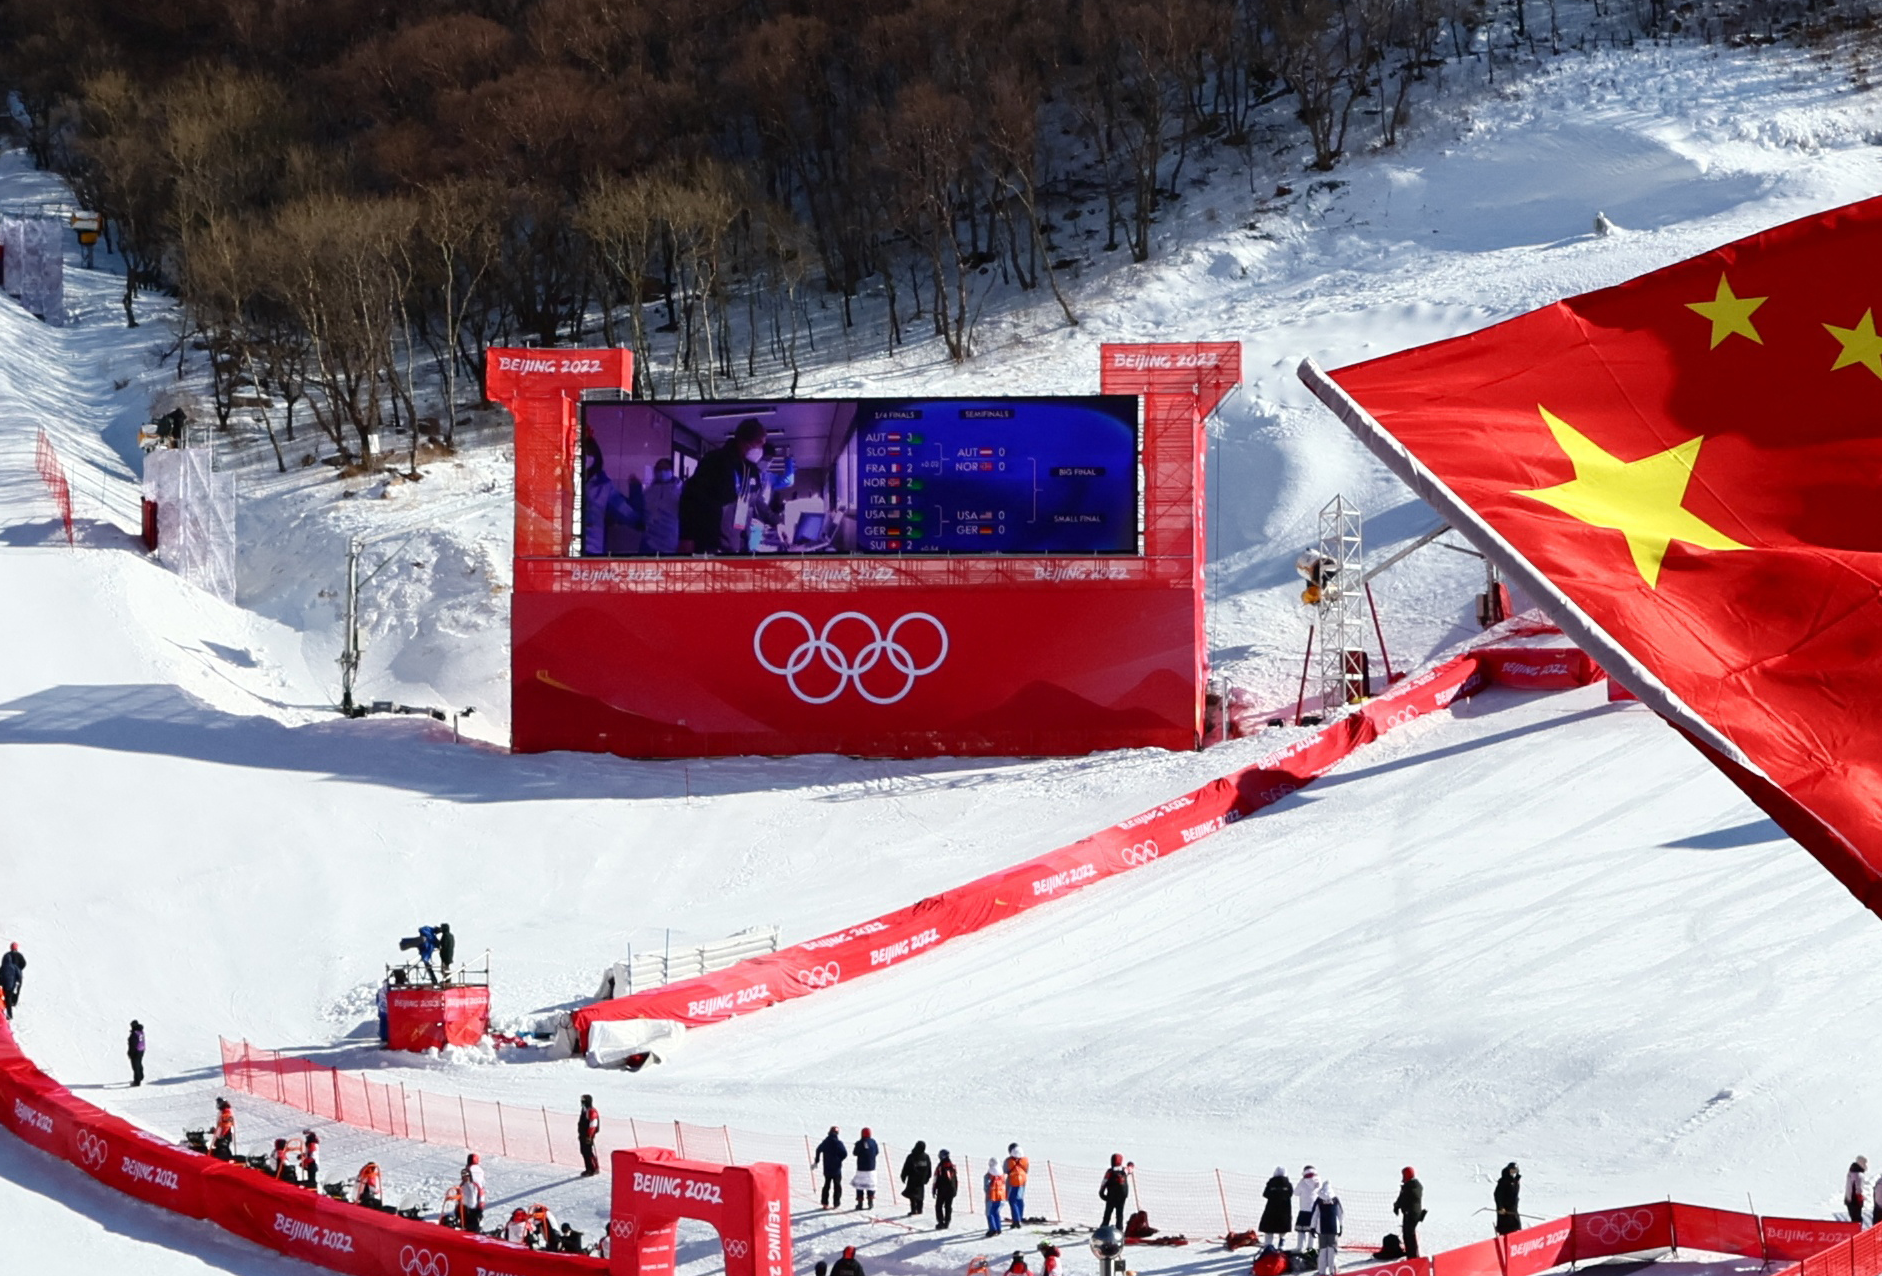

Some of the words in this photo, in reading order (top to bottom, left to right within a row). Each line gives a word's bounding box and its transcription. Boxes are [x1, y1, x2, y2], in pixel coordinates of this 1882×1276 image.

[499, 356, 556, 375] BEIJING
[560, 359, 603, 374] 2022
[1113, 353, 1172, 371] BEIJING
[1175, 352, 1220, 367] 2022
[888, 411, 915, 419] FINALS
[865, 433, 886, 442] AUT
[906, 432, 913, 442] 3
[866, 447, 886, 457] SLO
[957, 448, 978, 457] AUT
[998, 448, 1005, 457] 0
[866, 464, 886, 473] FRA
[906, 464, 913, 473] 2
[955, 462, 978, 471] NOR
[998, 462, 1005, 471] 0
[1059, 468, 1071, 476] BIG
[1073, 468, 1096, 476] FINAL
[863, 478, 886, 487] NOR
[906, 478, 913, 487] 2
[870, 495, 886, 504] ITA
[865, 510, 886, 519] USA
[906, 510, 913, 519] 3
[957, 511, 978, 520] USA
[998, 511, 1005, 520] 0
[1054, 515, 1078, 523] SMALL
[1080, 514, 1101, 522] FINAL
[864, 526, 886, 536] GER
[906, 526, 913, 536] 2
[956, 526, 978, 535] GER
[998, 526, 1005, 535] 0
[870, 540, 886, 549] SUI
[906, 540, 913, 549] 2
[571, 568, 622, 583] BEIJING
[626, 568, 665, 581] 2022
[802, 568, 851, 582] BEIJING
[856, 568, 894, 581] 2022
[1033, 567, 1087, 582] BEIJING
[1090, 567, 1130, 580] 2022
[1032, 872, 1070, 896] BEIJING
[1070, 863, 1097, 882] 2022
[870, 939, 909, 966] BEIJING
[911, 928, 941, 950] 2022
[688, 993, 734, 1018] BEIJING
[736, 983, 770, 1004] 2022
[121, 1156, 154, 1182] BEIJING
[155, 1166, 179, 1189] 2022
[633, 1171, 682, 1199] BEIJING
[684, 1180, 724, 1204] 2022
[273, 1212, 319, 1244] BEIJING
[321, 1226, 354, 1253] 2022
[764, 1199, 781, 1261] BEIJING
[1767, 1227, 1814, 1244] BEIJING
[1817, 1230, 1852, 1243] 2022
[1510, 1233, 1547, 1257] BEIJING
[1547, 1228, 1571, 1246] 2022
